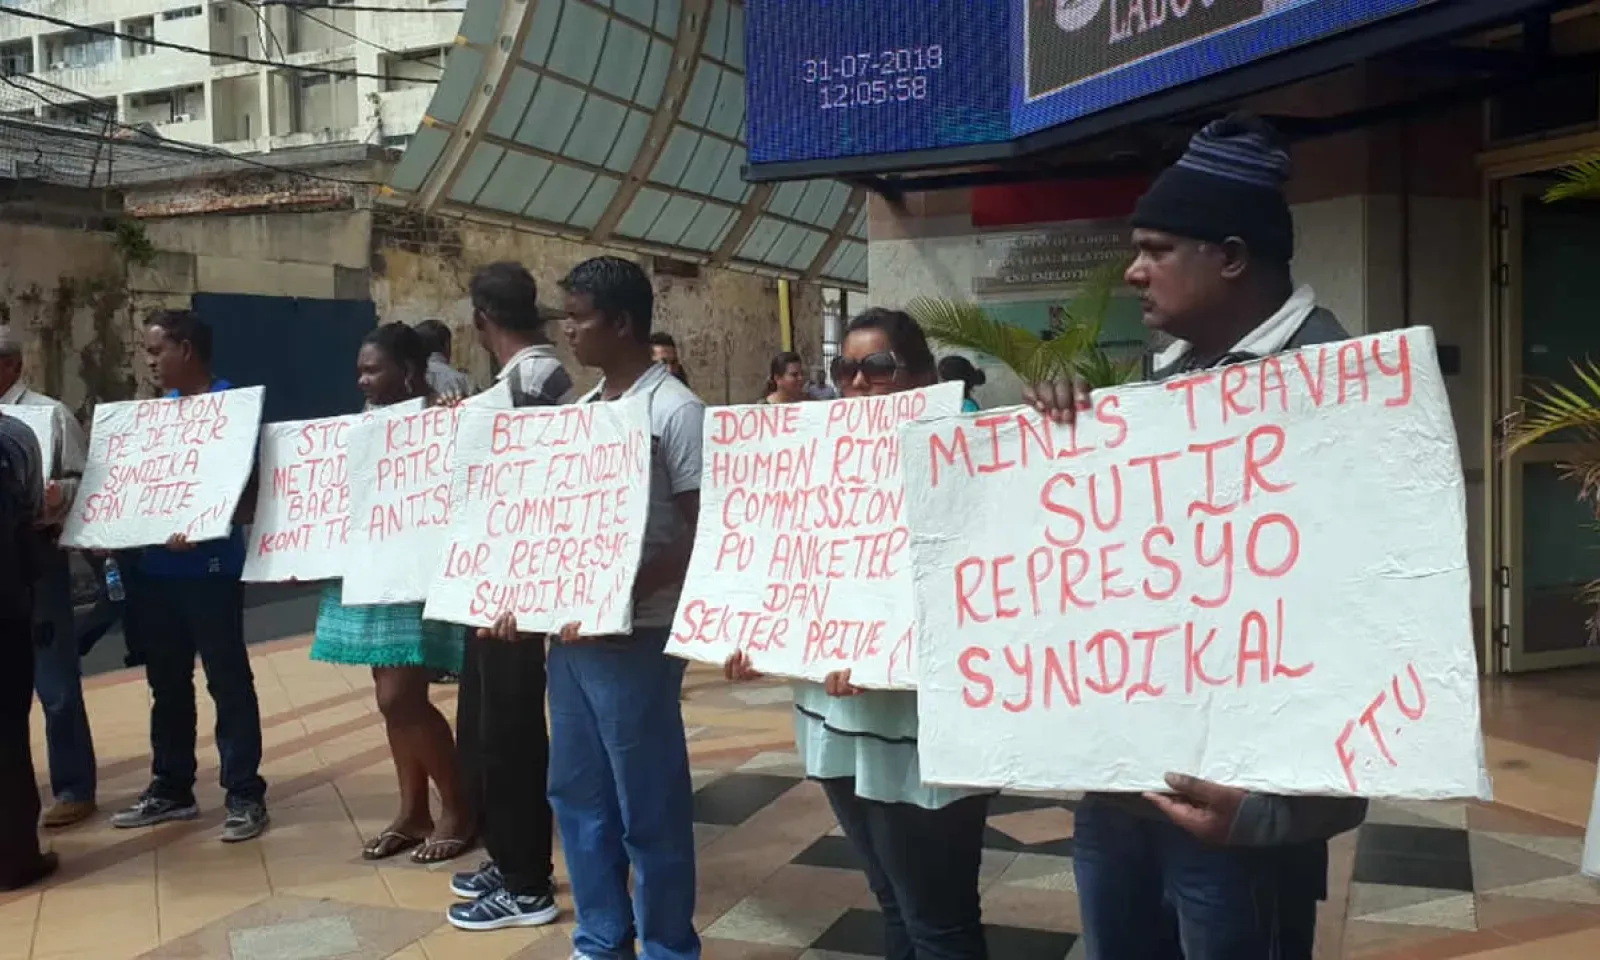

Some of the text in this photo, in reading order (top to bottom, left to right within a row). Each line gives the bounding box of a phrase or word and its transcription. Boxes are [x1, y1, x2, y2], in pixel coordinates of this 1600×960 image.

[802, 44, 942, 83] 31-07-2018
[820, 75, 927, 109] 12:05:58
[135, 392, 225, 429] PATRON
[491, 404, 594, 455] BIZIN
[711, 407, 800, 445] DONE
[929, 334, 1412, 487] MINIS TRAVAY
[104, 448, 199, 494] SYNDIKA
[105, 432, 135, 464] PE
[712, 437, 818, 488] HUMAN
[465, 459, 537, 504] FACT
[1040, 424, 1297, 548] SUTIR
[81, 491, 128, 523] SAN
[486, 485, 630, 538] COMMITEE
[722, 484, 904, 533] COMMISSION
[258, 523, 316, 557] KONT
[444, 542, 491, 579] LOR
[714, 526, 910, 581] PU ANKETER
[954, 512, 1301, 629] REPRESYO
[469, 570, 596, 622] SYNDIKAL
[762, 580, 832, 620] DAN
[673, 599, 887, 665] SEKTER PRIVE
[957, 597, 1315, 712] SYNDIKAL
